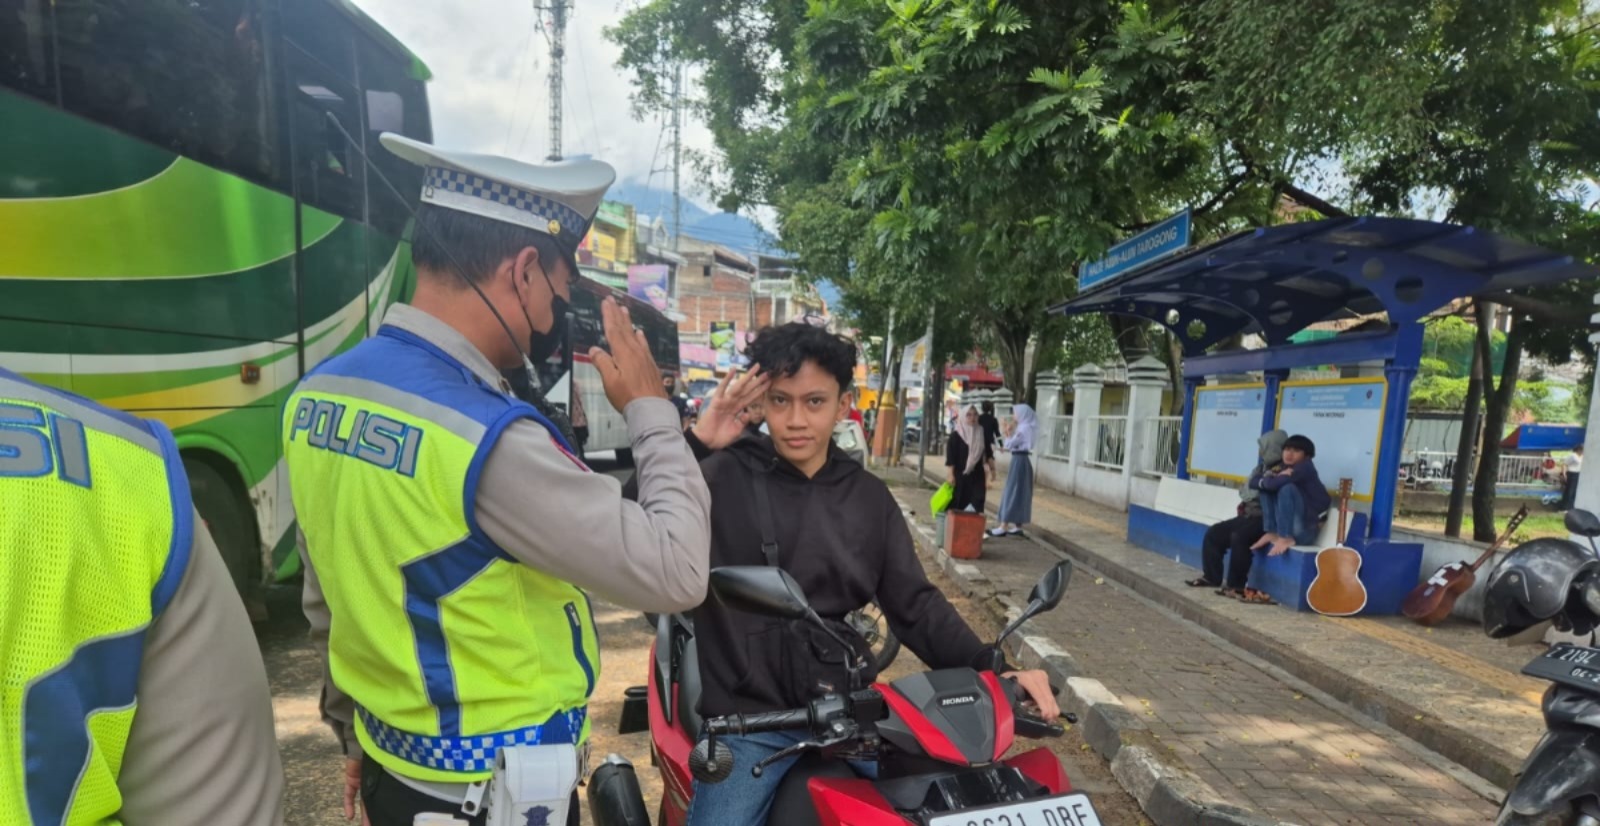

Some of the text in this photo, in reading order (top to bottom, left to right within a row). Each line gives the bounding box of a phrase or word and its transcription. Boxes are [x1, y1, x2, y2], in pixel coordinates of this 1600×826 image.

[1137, 226, 1177, 255] TAROGONG
[290, 397, 424, 478] POLISI
[1545, 646, 1562, 657] Z
[942, 695, 975, 706] HONDA
